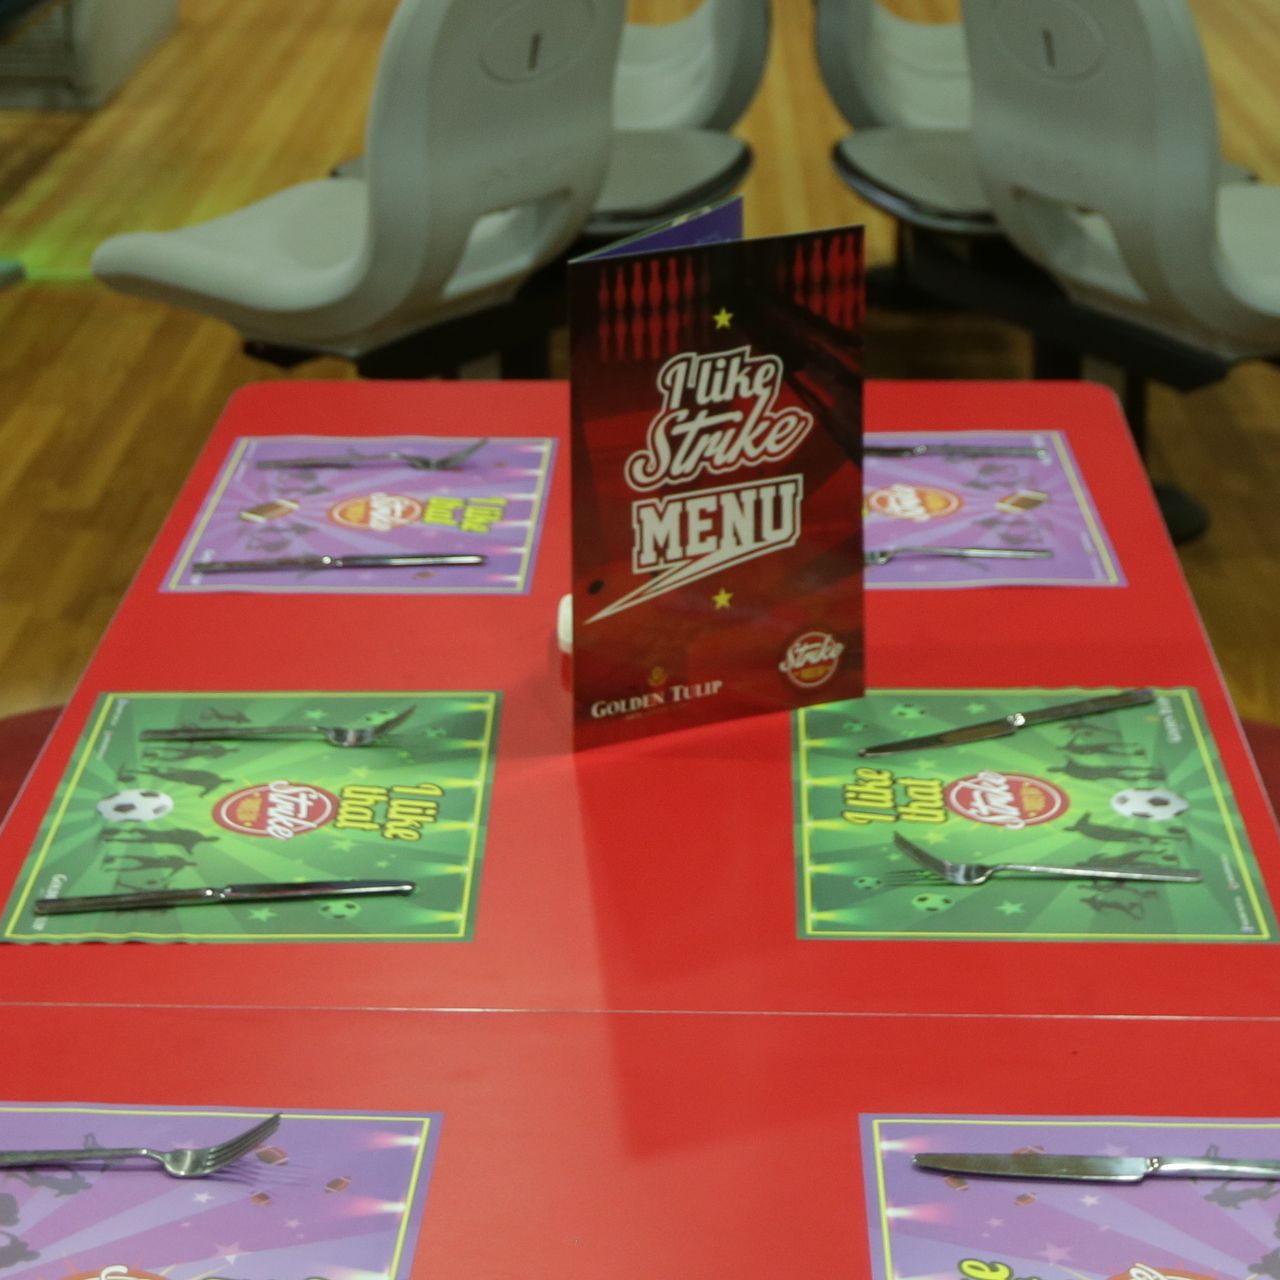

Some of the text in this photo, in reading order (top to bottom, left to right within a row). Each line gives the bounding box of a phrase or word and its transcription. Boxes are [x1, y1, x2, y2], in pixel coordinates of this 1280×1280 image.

[696, 354, 776, 405] like
[630, 396, 807, 485] Strike
[637, 482, 797, 567] MENU
[591, 691, 665, 718] GOLDEN
[670, 680, 723, 702] TULIP
[264, 780, 320, 841] Strike
[335, 785, 389, 832] that
[842, 767, 896, 809] like
[895, 776, 947, 824] that
[384, 798, 439, 841] like
